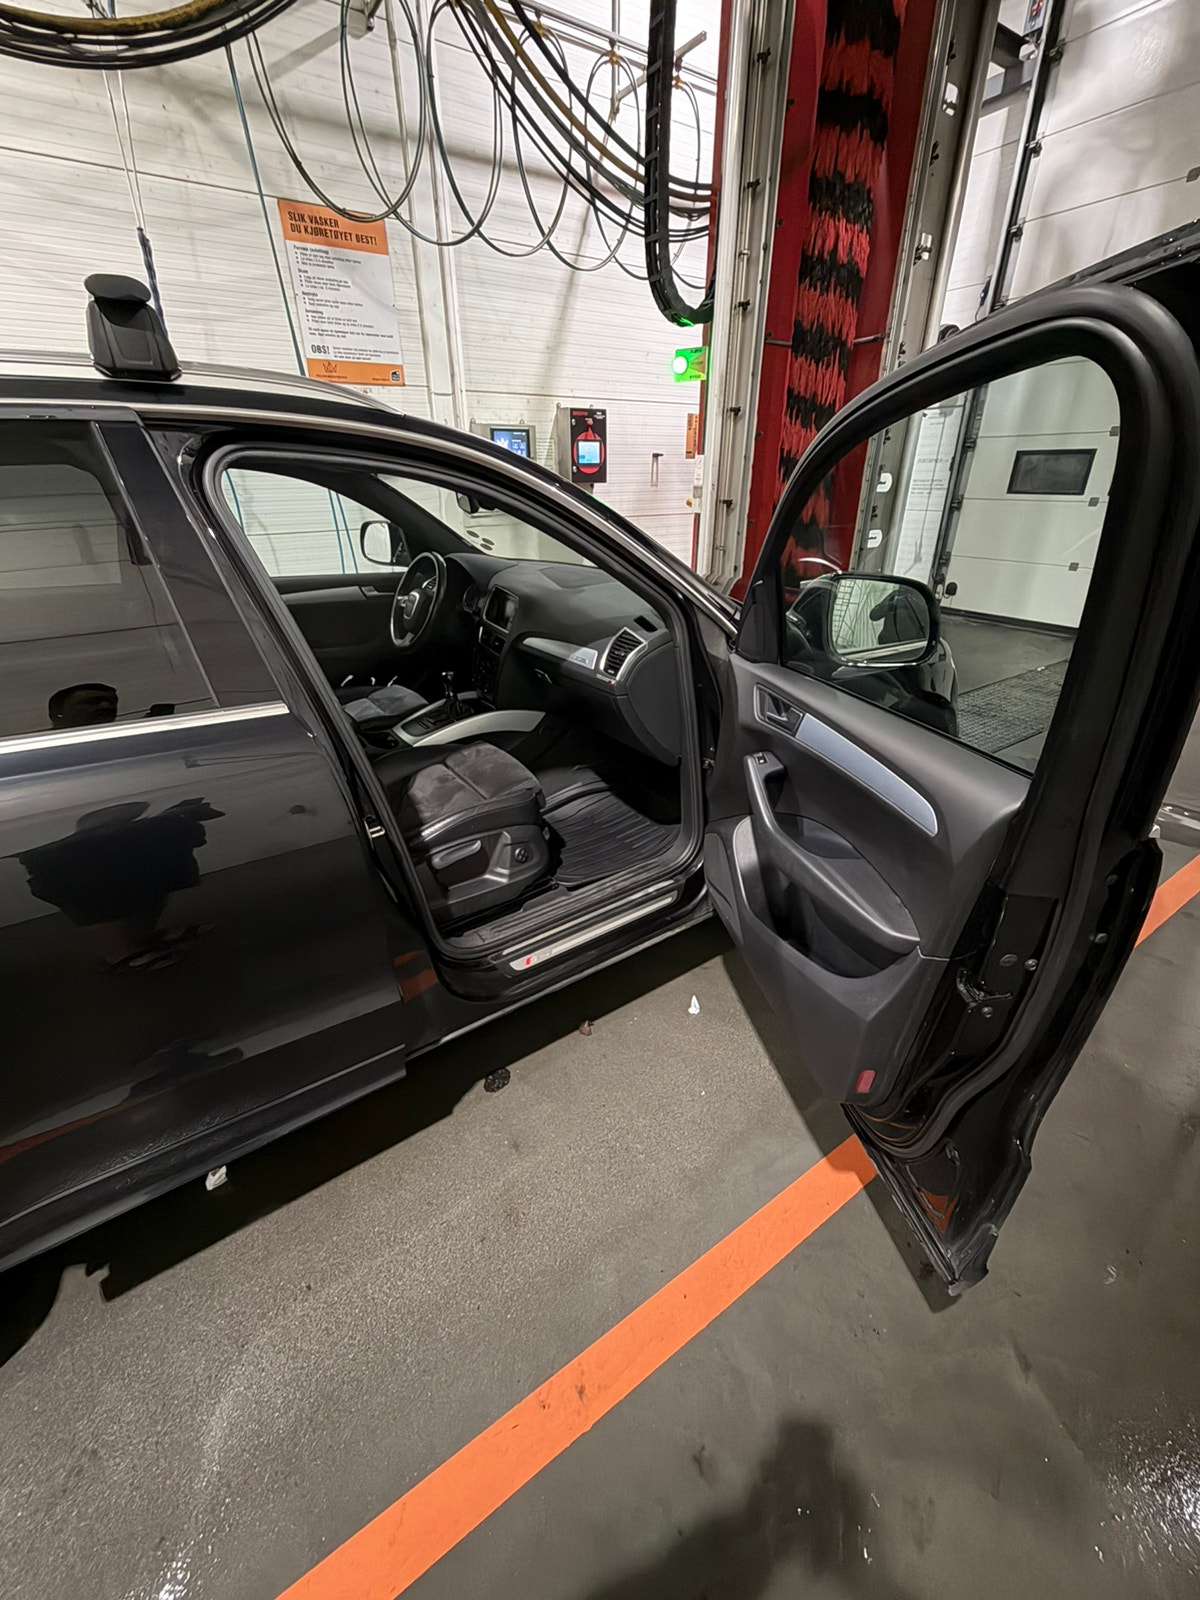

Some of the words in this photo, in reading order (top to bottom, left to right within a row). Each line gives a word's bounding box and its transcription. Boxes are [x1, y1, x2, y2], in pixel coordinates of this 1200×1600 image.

[288, 211, 307, 222] SLIK
[307, 215, 340, 228] VASKER
[290, 223, 301, 233] DU
[304, 224, 353, 241] KJØRETØYET
[355, 233, 378, 246] BEST!
[311, 344, 330, 355] OBS!
